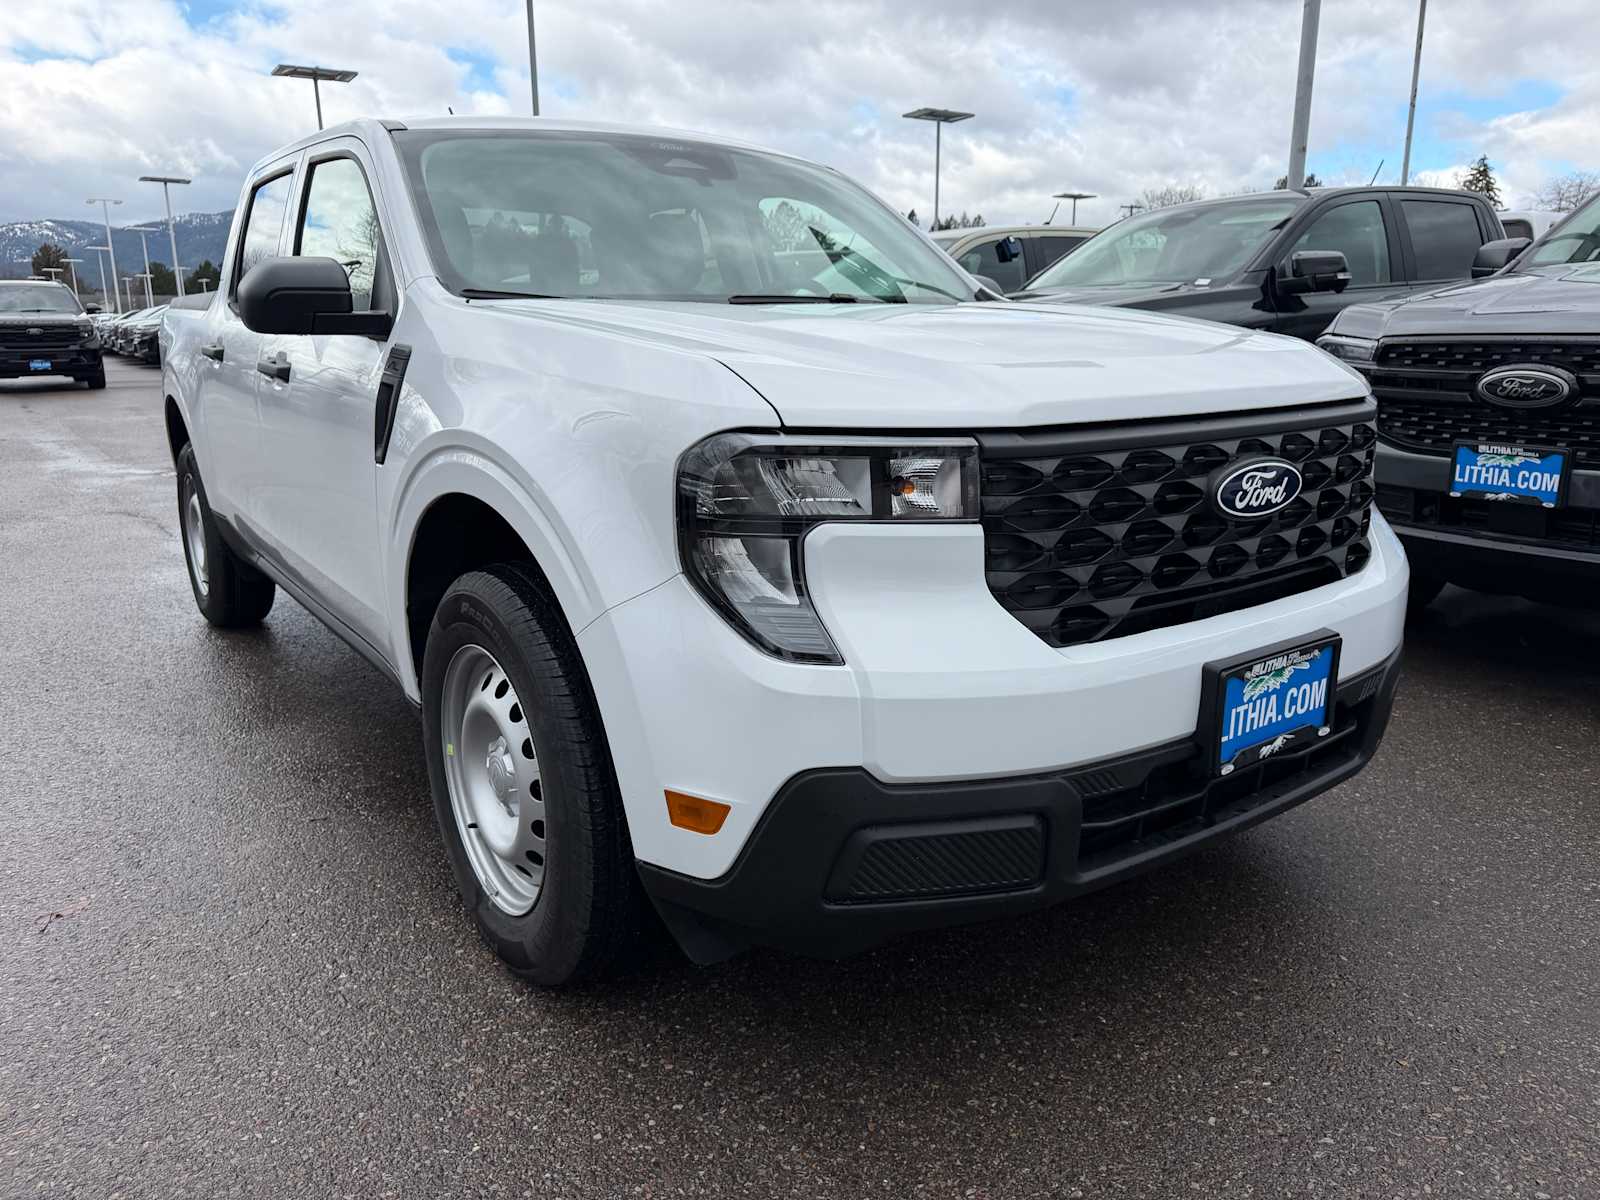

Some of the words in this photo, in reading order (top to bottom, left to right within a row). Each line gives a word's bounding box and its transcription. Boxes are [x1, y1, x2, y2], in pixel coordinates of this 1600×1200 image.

[1496, 377, 1547, 398] Ford
[1235, 470, 1289, 509] Ford
[1454, 464, 1560, 493] LITHIA.COM
[1258, 655, 1288, 675] LITHIA
